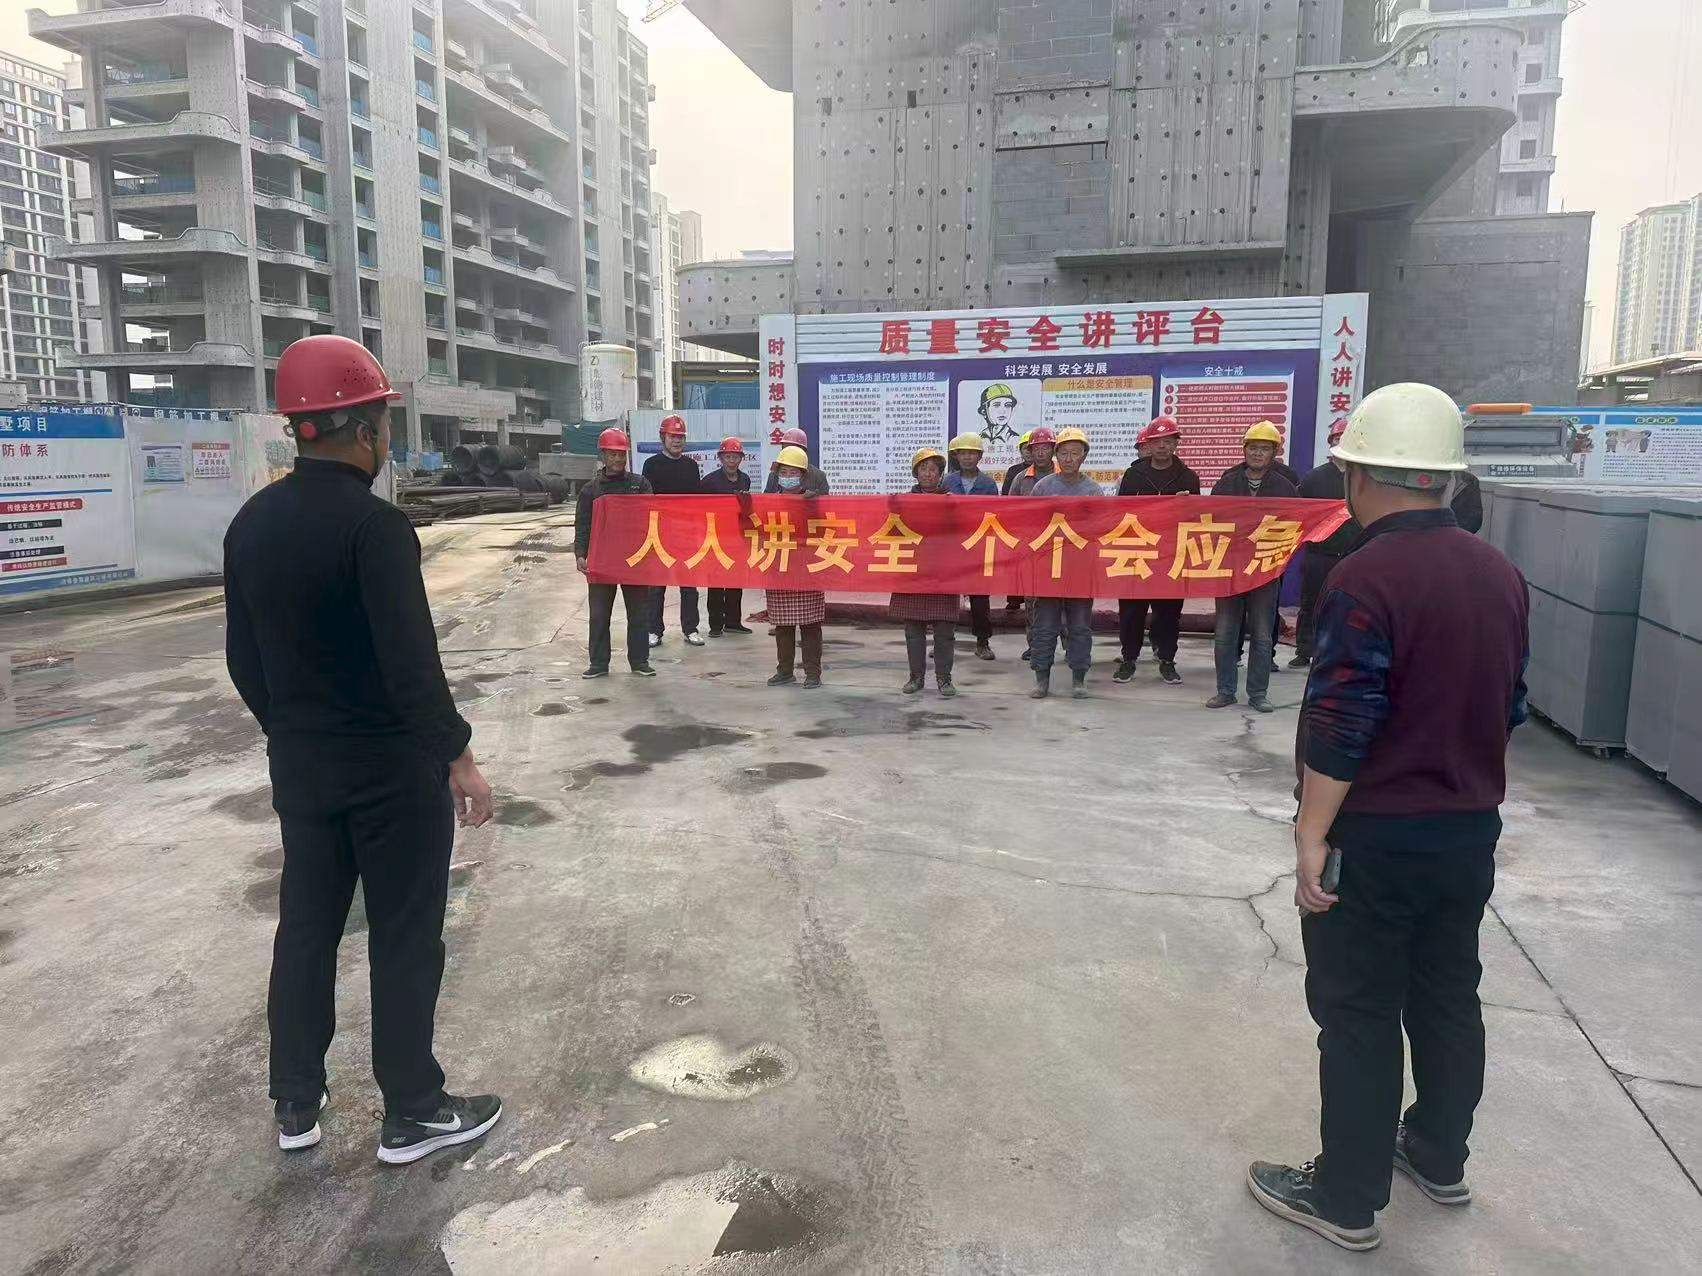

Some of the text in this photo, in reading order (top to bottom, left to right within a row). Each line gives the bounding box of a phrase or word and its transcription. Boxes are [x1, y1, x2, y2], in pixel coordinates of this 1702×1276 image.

[879, 306, 1225, 355] 质量安全讲评台
[1004, 362, 1108, 377] 科学发展 安全发展
[1204, 366, 1245, 377] 安全十戒
[830, 371, 936, 384] 施工现场质量控制管理制度
[1067, 378, 1134, 391] 什么是安全管理
[0, 415, 48, 432] 墅项目
[2, 443, 49, 457] 防体系
[6, 501, 77, 512] 传统安全生产监管模式
[624, 510, 1304, 580] 人人讲安全 个个会应急
